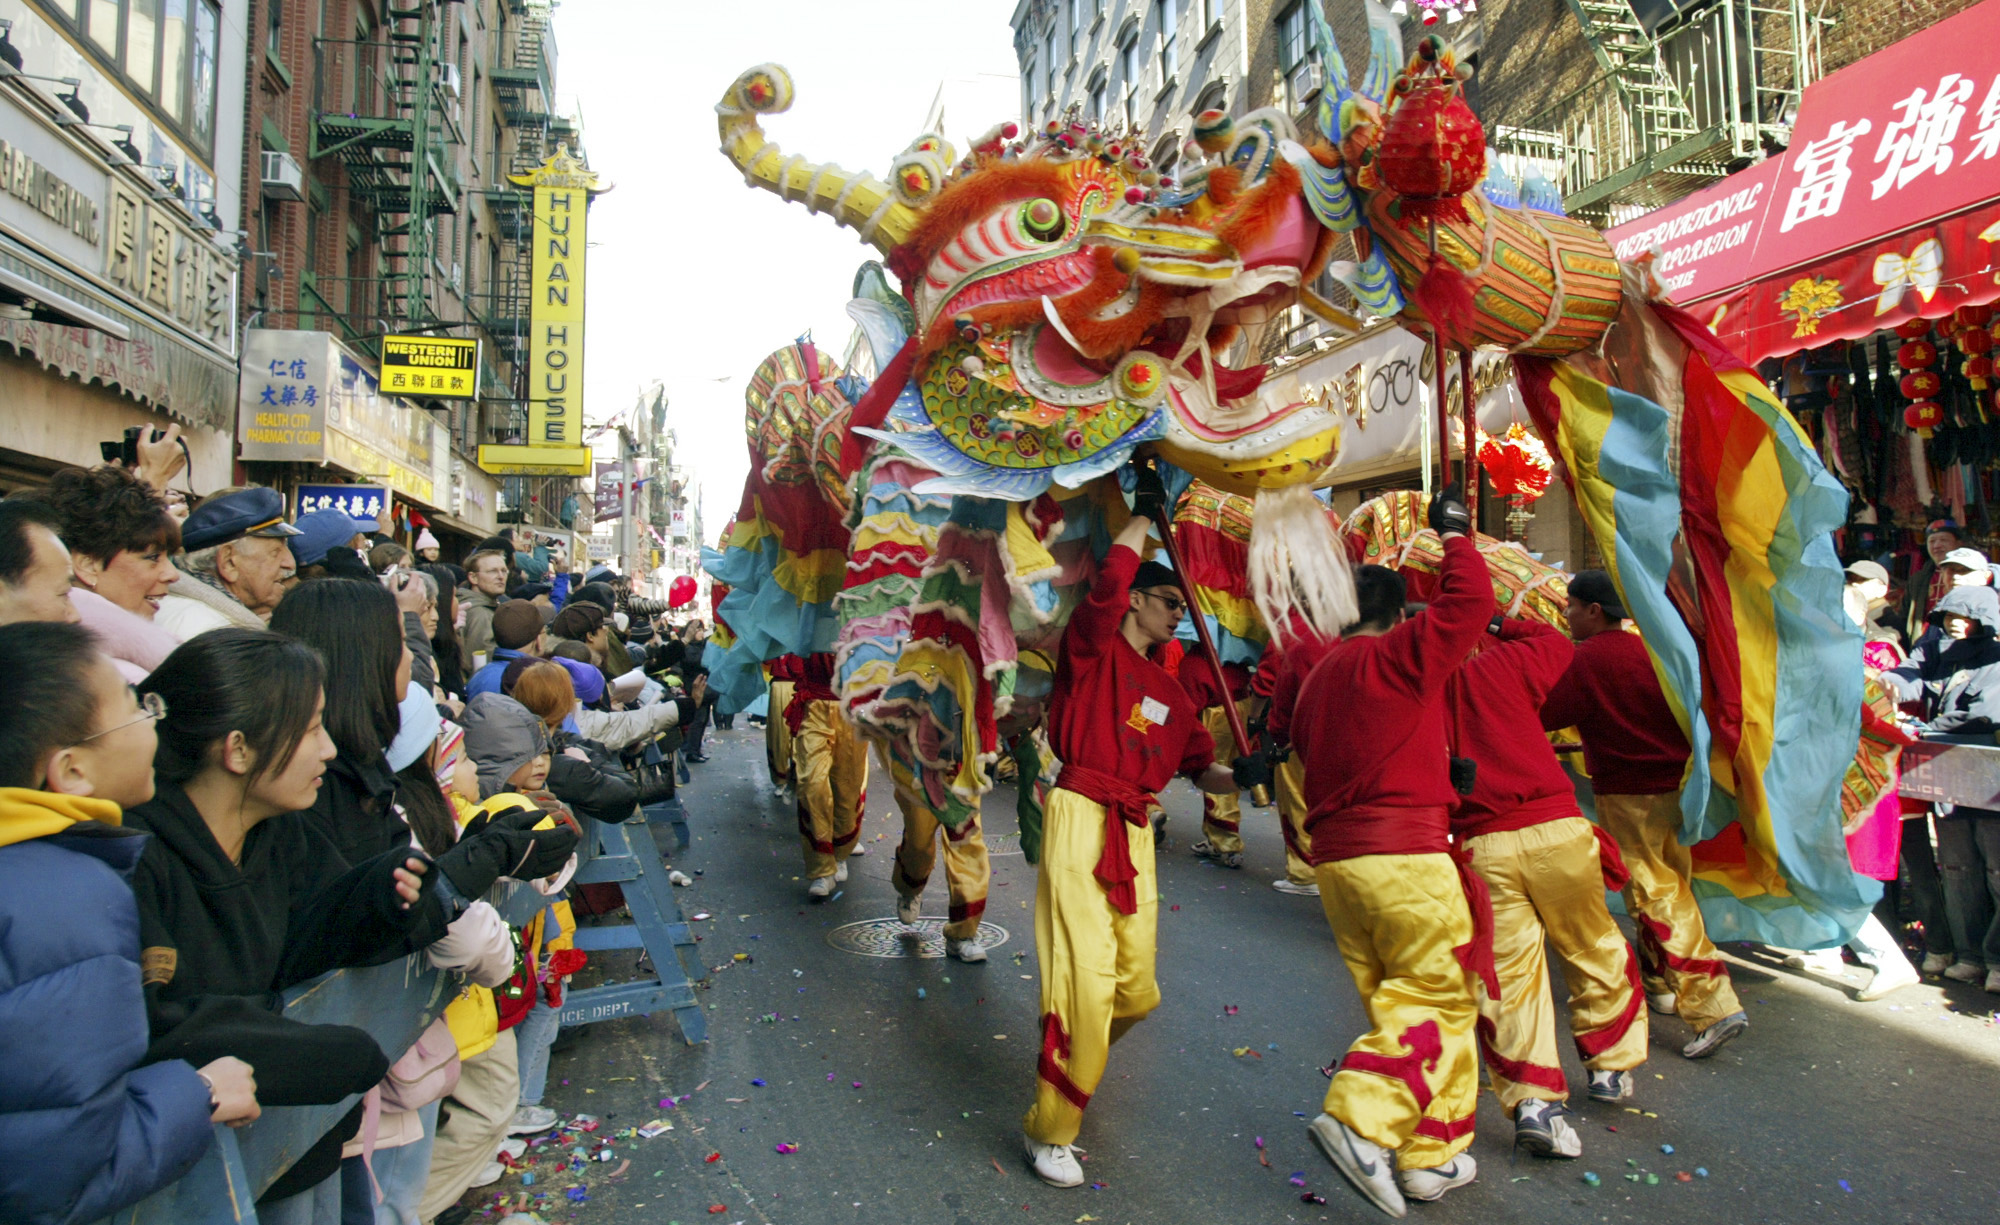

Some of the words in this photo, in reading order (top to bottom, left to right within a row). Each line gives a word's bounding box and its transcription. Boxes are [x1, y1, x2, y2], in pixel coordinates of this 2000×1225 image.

[9, 147, 75, 229] BAKERY
[1615, 182, 1764, 260] INTERNATIONAL
[547, 192, 570, 306] HUNAN
[1659, 220, 1753, 272] RPORATION
[106, 176, 232, 343] 鳳凰餅家
[386, 343, 456, 357] WESTERN
[408, 354, 455, 367] UNION
[268, 359, 308, 380] 仁信
[392, 372, 464, 391] 西聯匯款
[545, 325, 568, 443] HOUSE
[259, 384, 320, 408] 大藥房
[255, 412, 288, 428] HEALTH
[291, 412, 311, 428] CITY
[246, 428, 295, 444] PHARMACY
[297, 430, 322, 445] CORP.
[301, 494, 381, 517] 仁信大藥房
[593, 1001, 635, 1019] DEPT.
